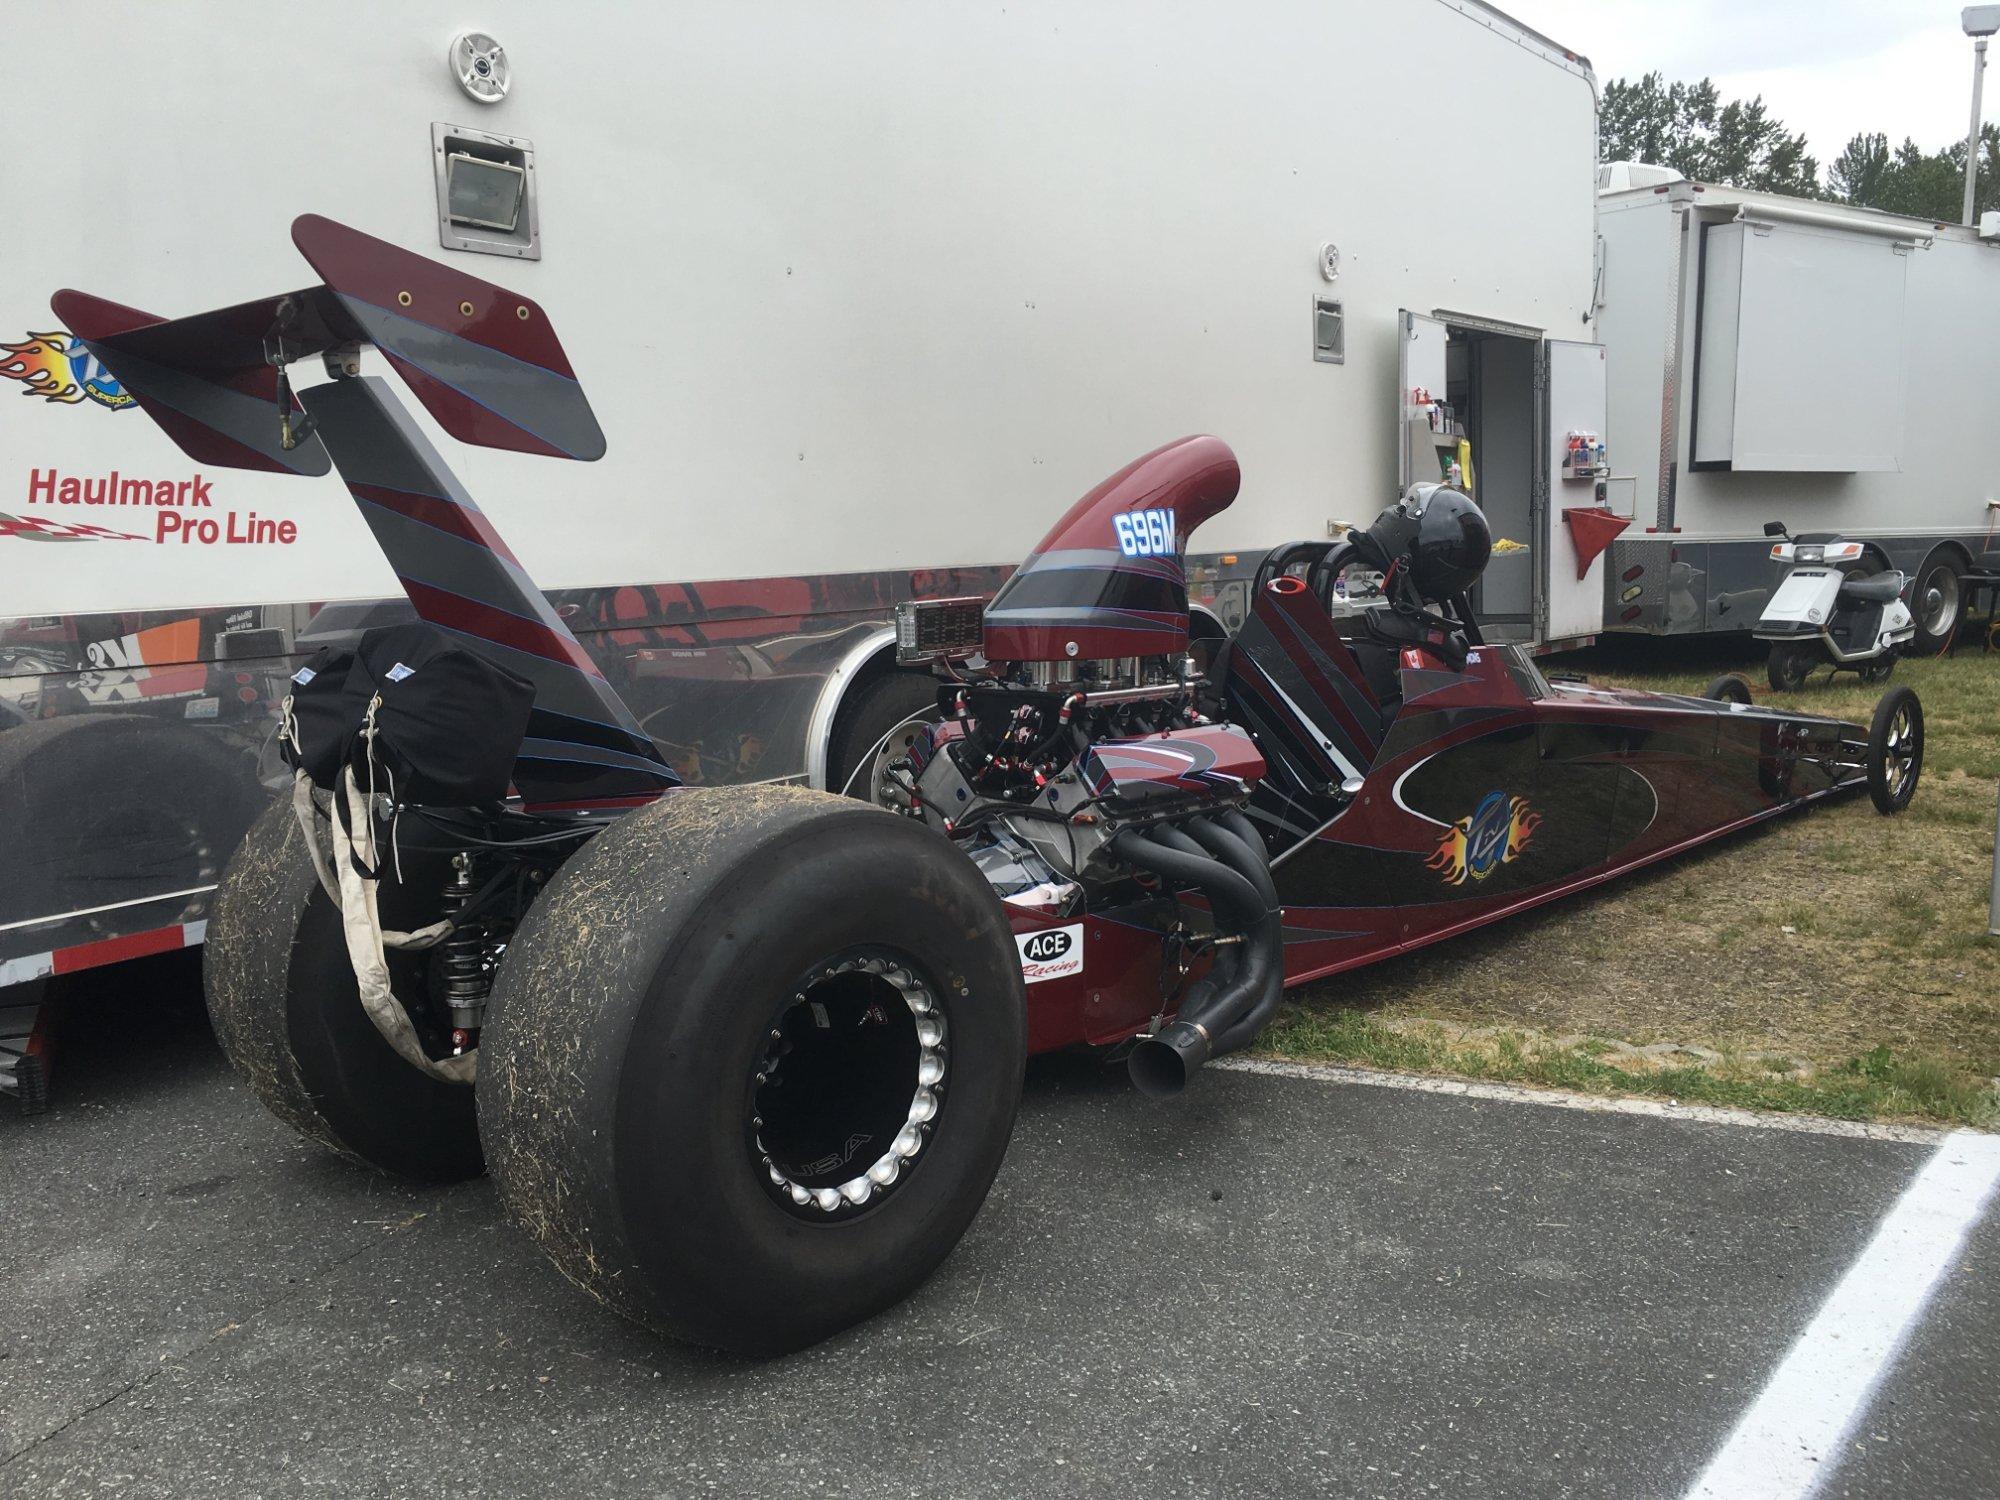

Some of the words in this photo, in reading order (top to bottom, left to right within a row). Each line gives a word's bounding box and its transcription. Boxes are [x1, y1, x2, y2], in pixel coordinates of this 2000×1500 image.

[28, 468, 214, 507] Haulmark
[156, 510, 219, 544] Pro
[226, 511, 298, 544] Line
[1113, 507, 1175, 558] 696M
[1029, 933, 1066, 958] ACE
[1022, 960, 1079, 978] Racing
[782, 1133, 873, 1176] USA
